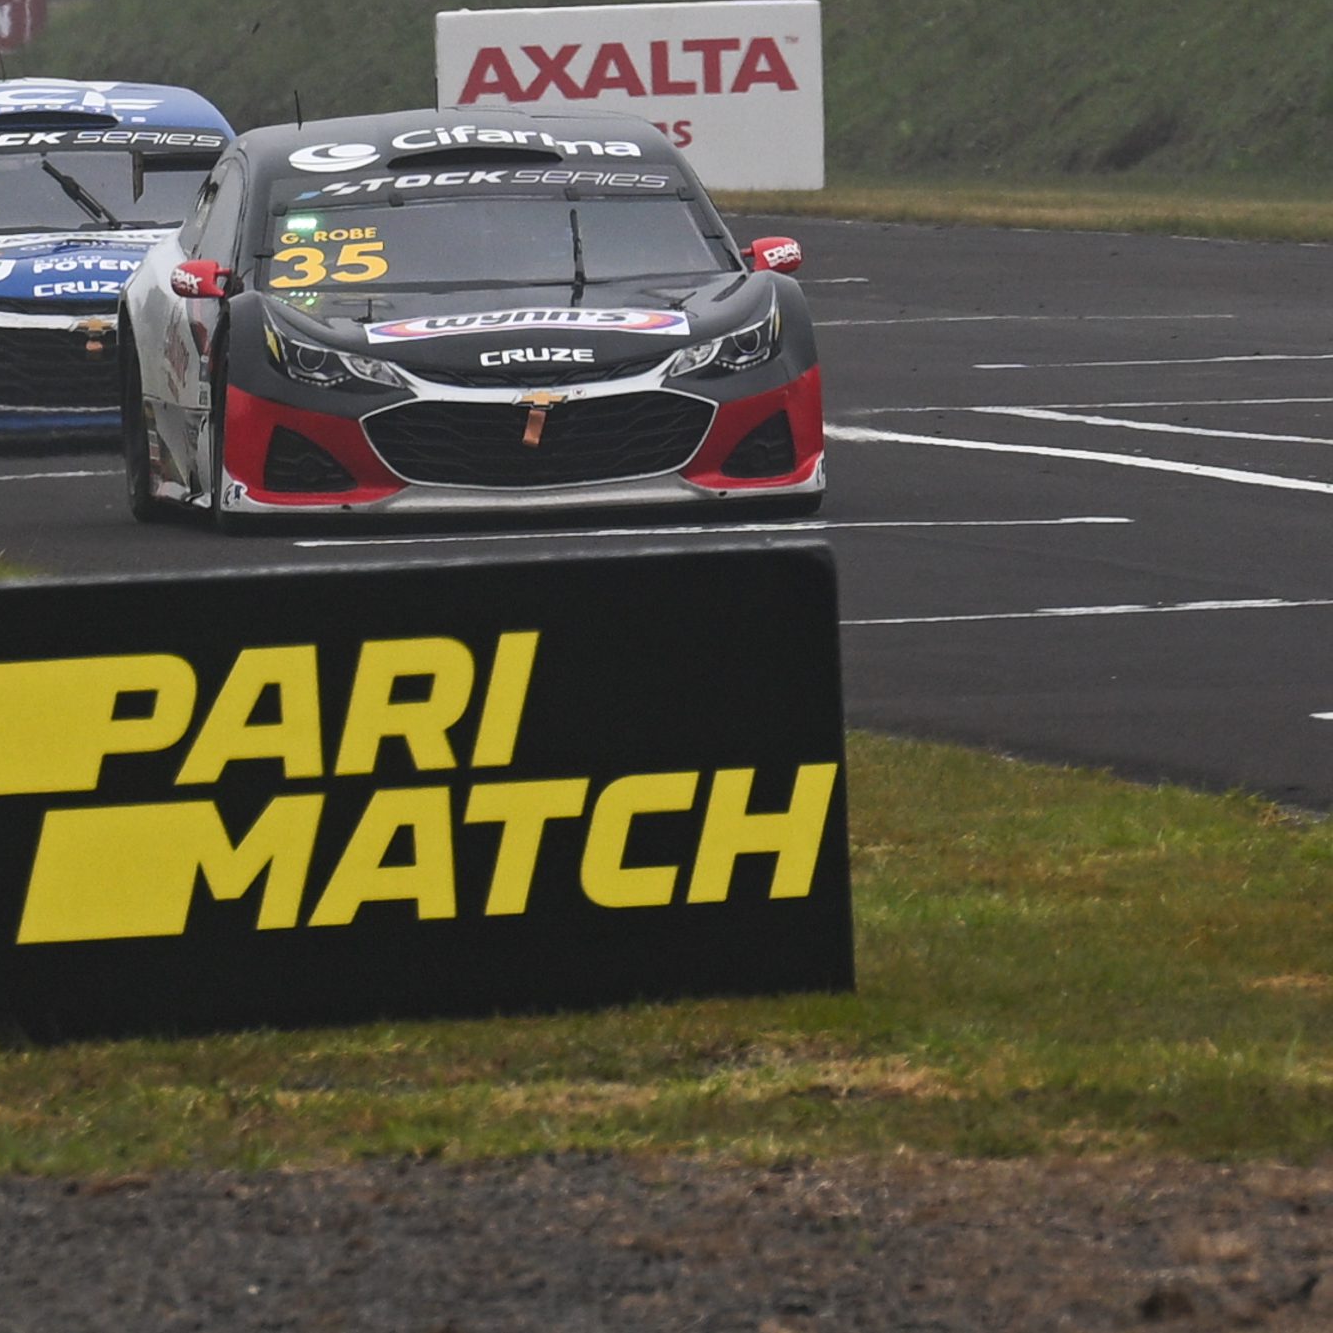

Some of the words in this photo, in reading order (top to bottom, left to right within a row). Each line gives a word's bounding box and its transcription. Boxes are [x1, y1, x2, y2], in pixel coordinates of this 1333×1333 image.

[457, 37, 799, 104] AXALTA
[72, 131, 224, 148] SERIES
[392, 126, 641, 157] Cifarma
[321, 171, 510, 196] STOCK
[511, 170, 670, 188] SERIES
[280, 233, 306, 245] G.
[313, 227, 378, 242] ROBE
[268, 241, 389, 288] 35
[480, 347, 595, 366] CRUZE
[17, 761, 837, 943] MATCH
